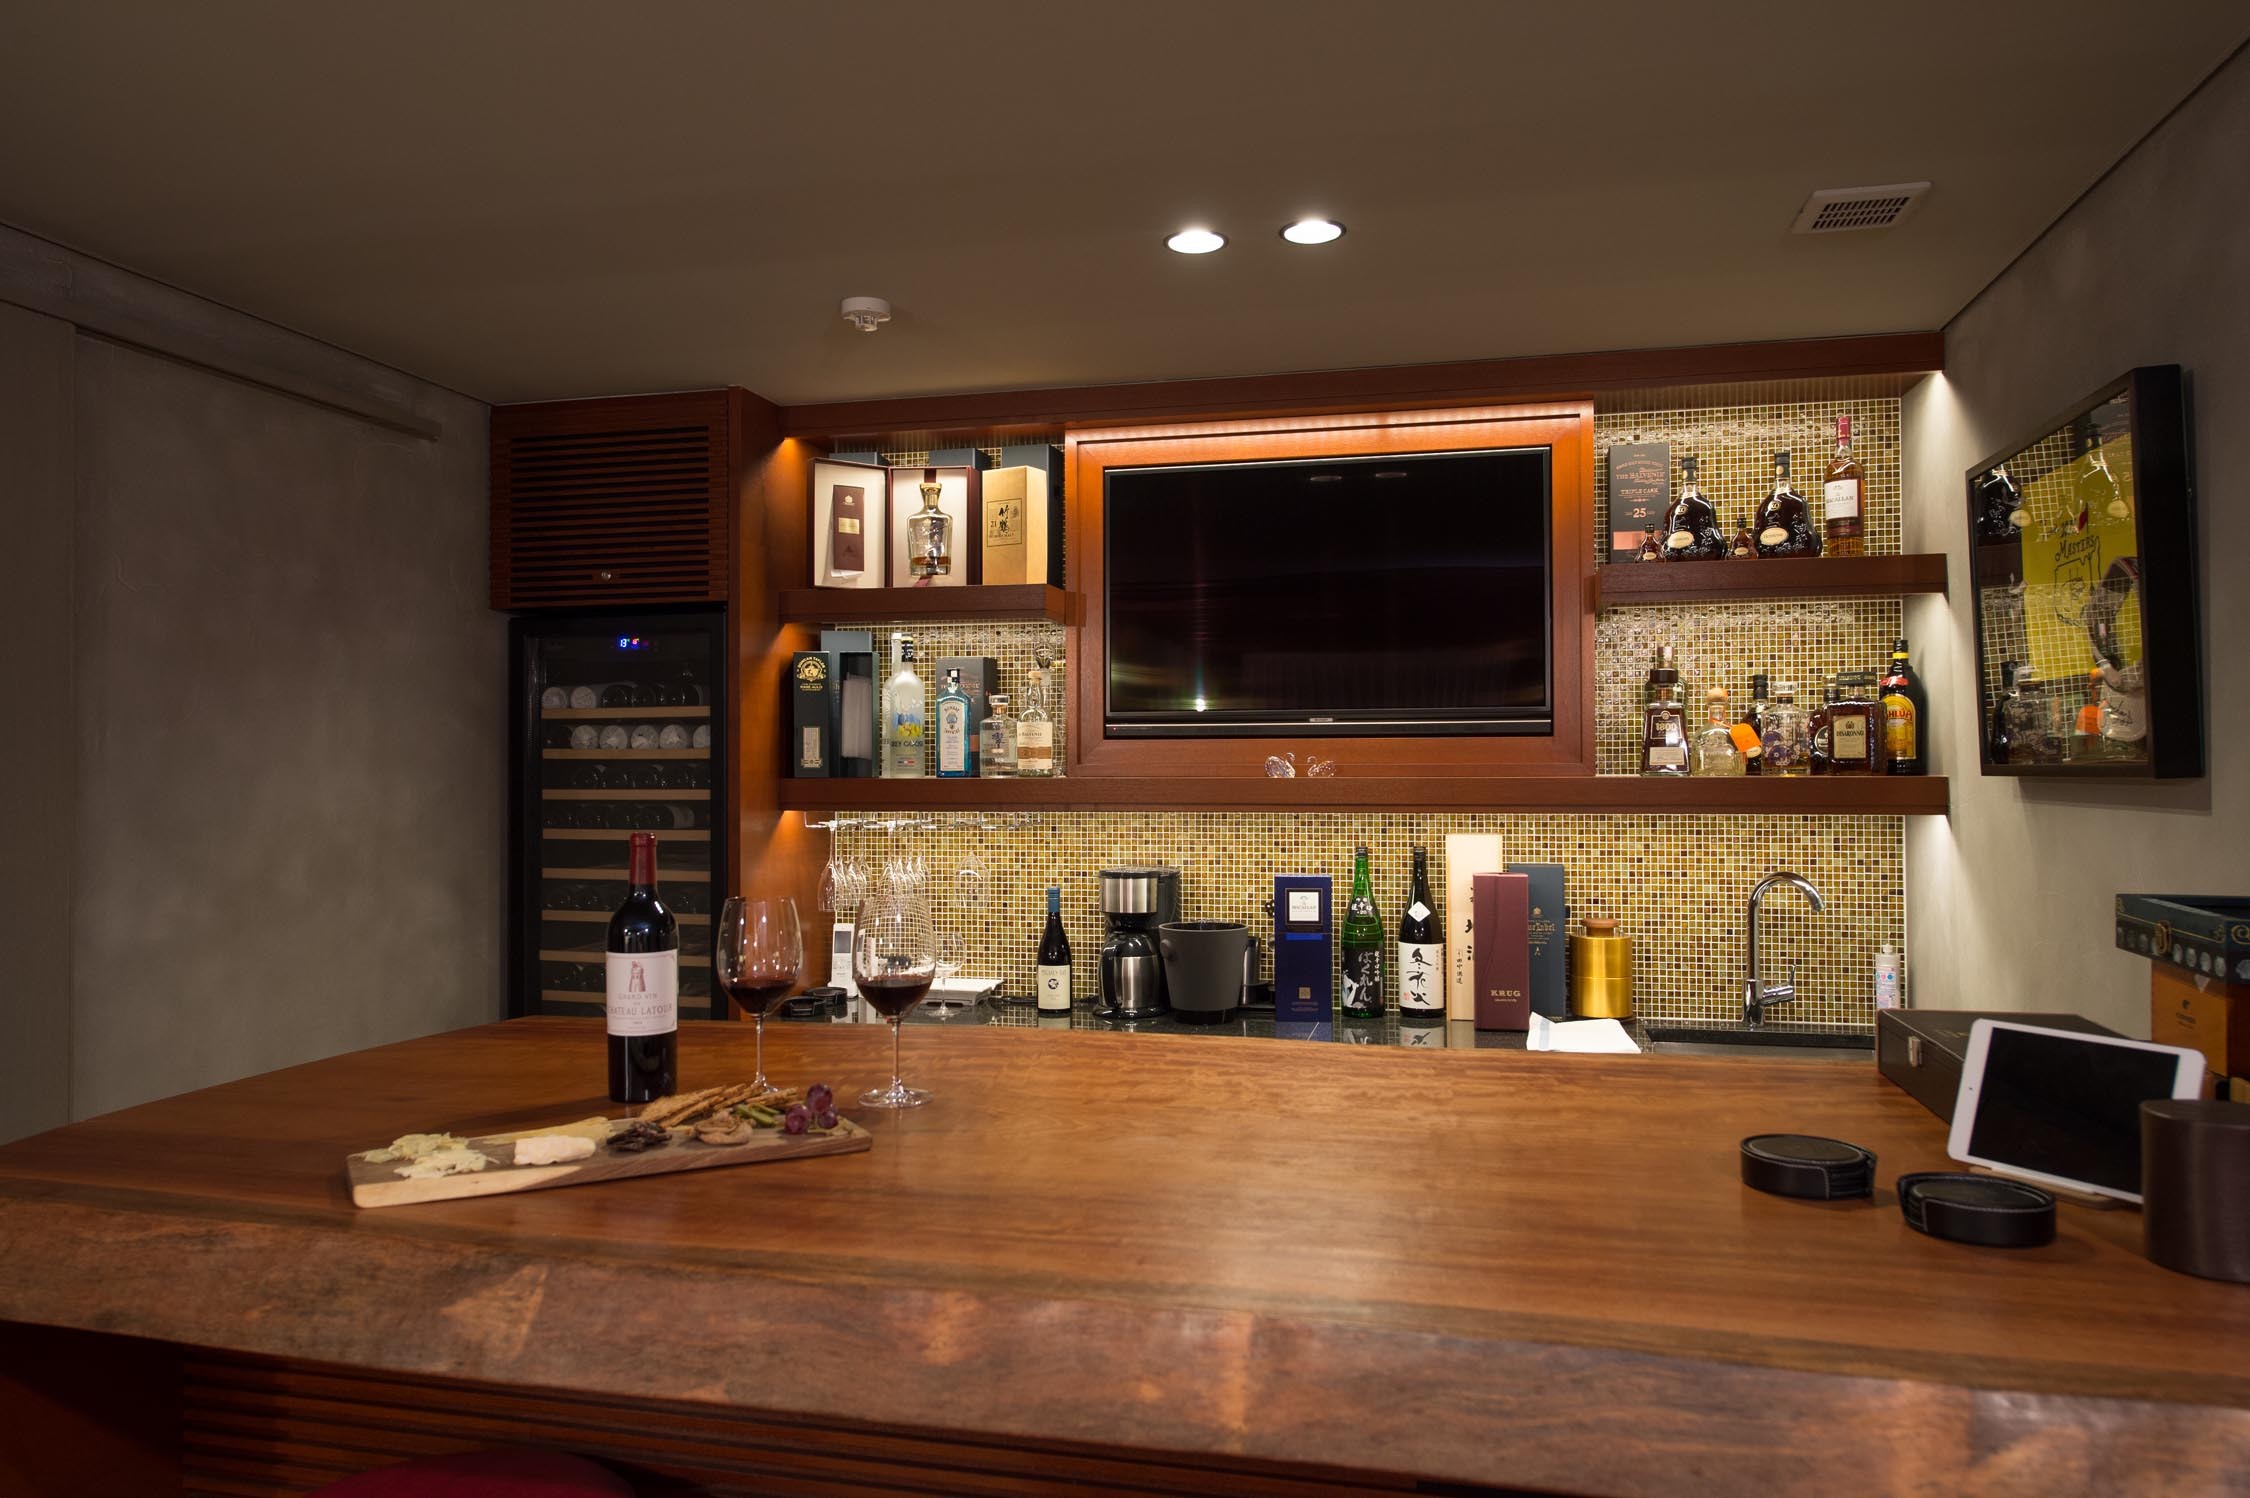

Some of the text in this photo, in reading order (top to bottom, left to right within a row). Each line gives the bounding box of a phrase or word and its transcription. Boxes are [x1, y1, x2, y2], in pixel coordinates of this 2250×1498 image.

[1633, 507, 1647, 518] 25
[990, 520, 997, 528] 21
[1655, 723, 1678, 731] 1800
[1490, 989, 1521, 997] KRUG
